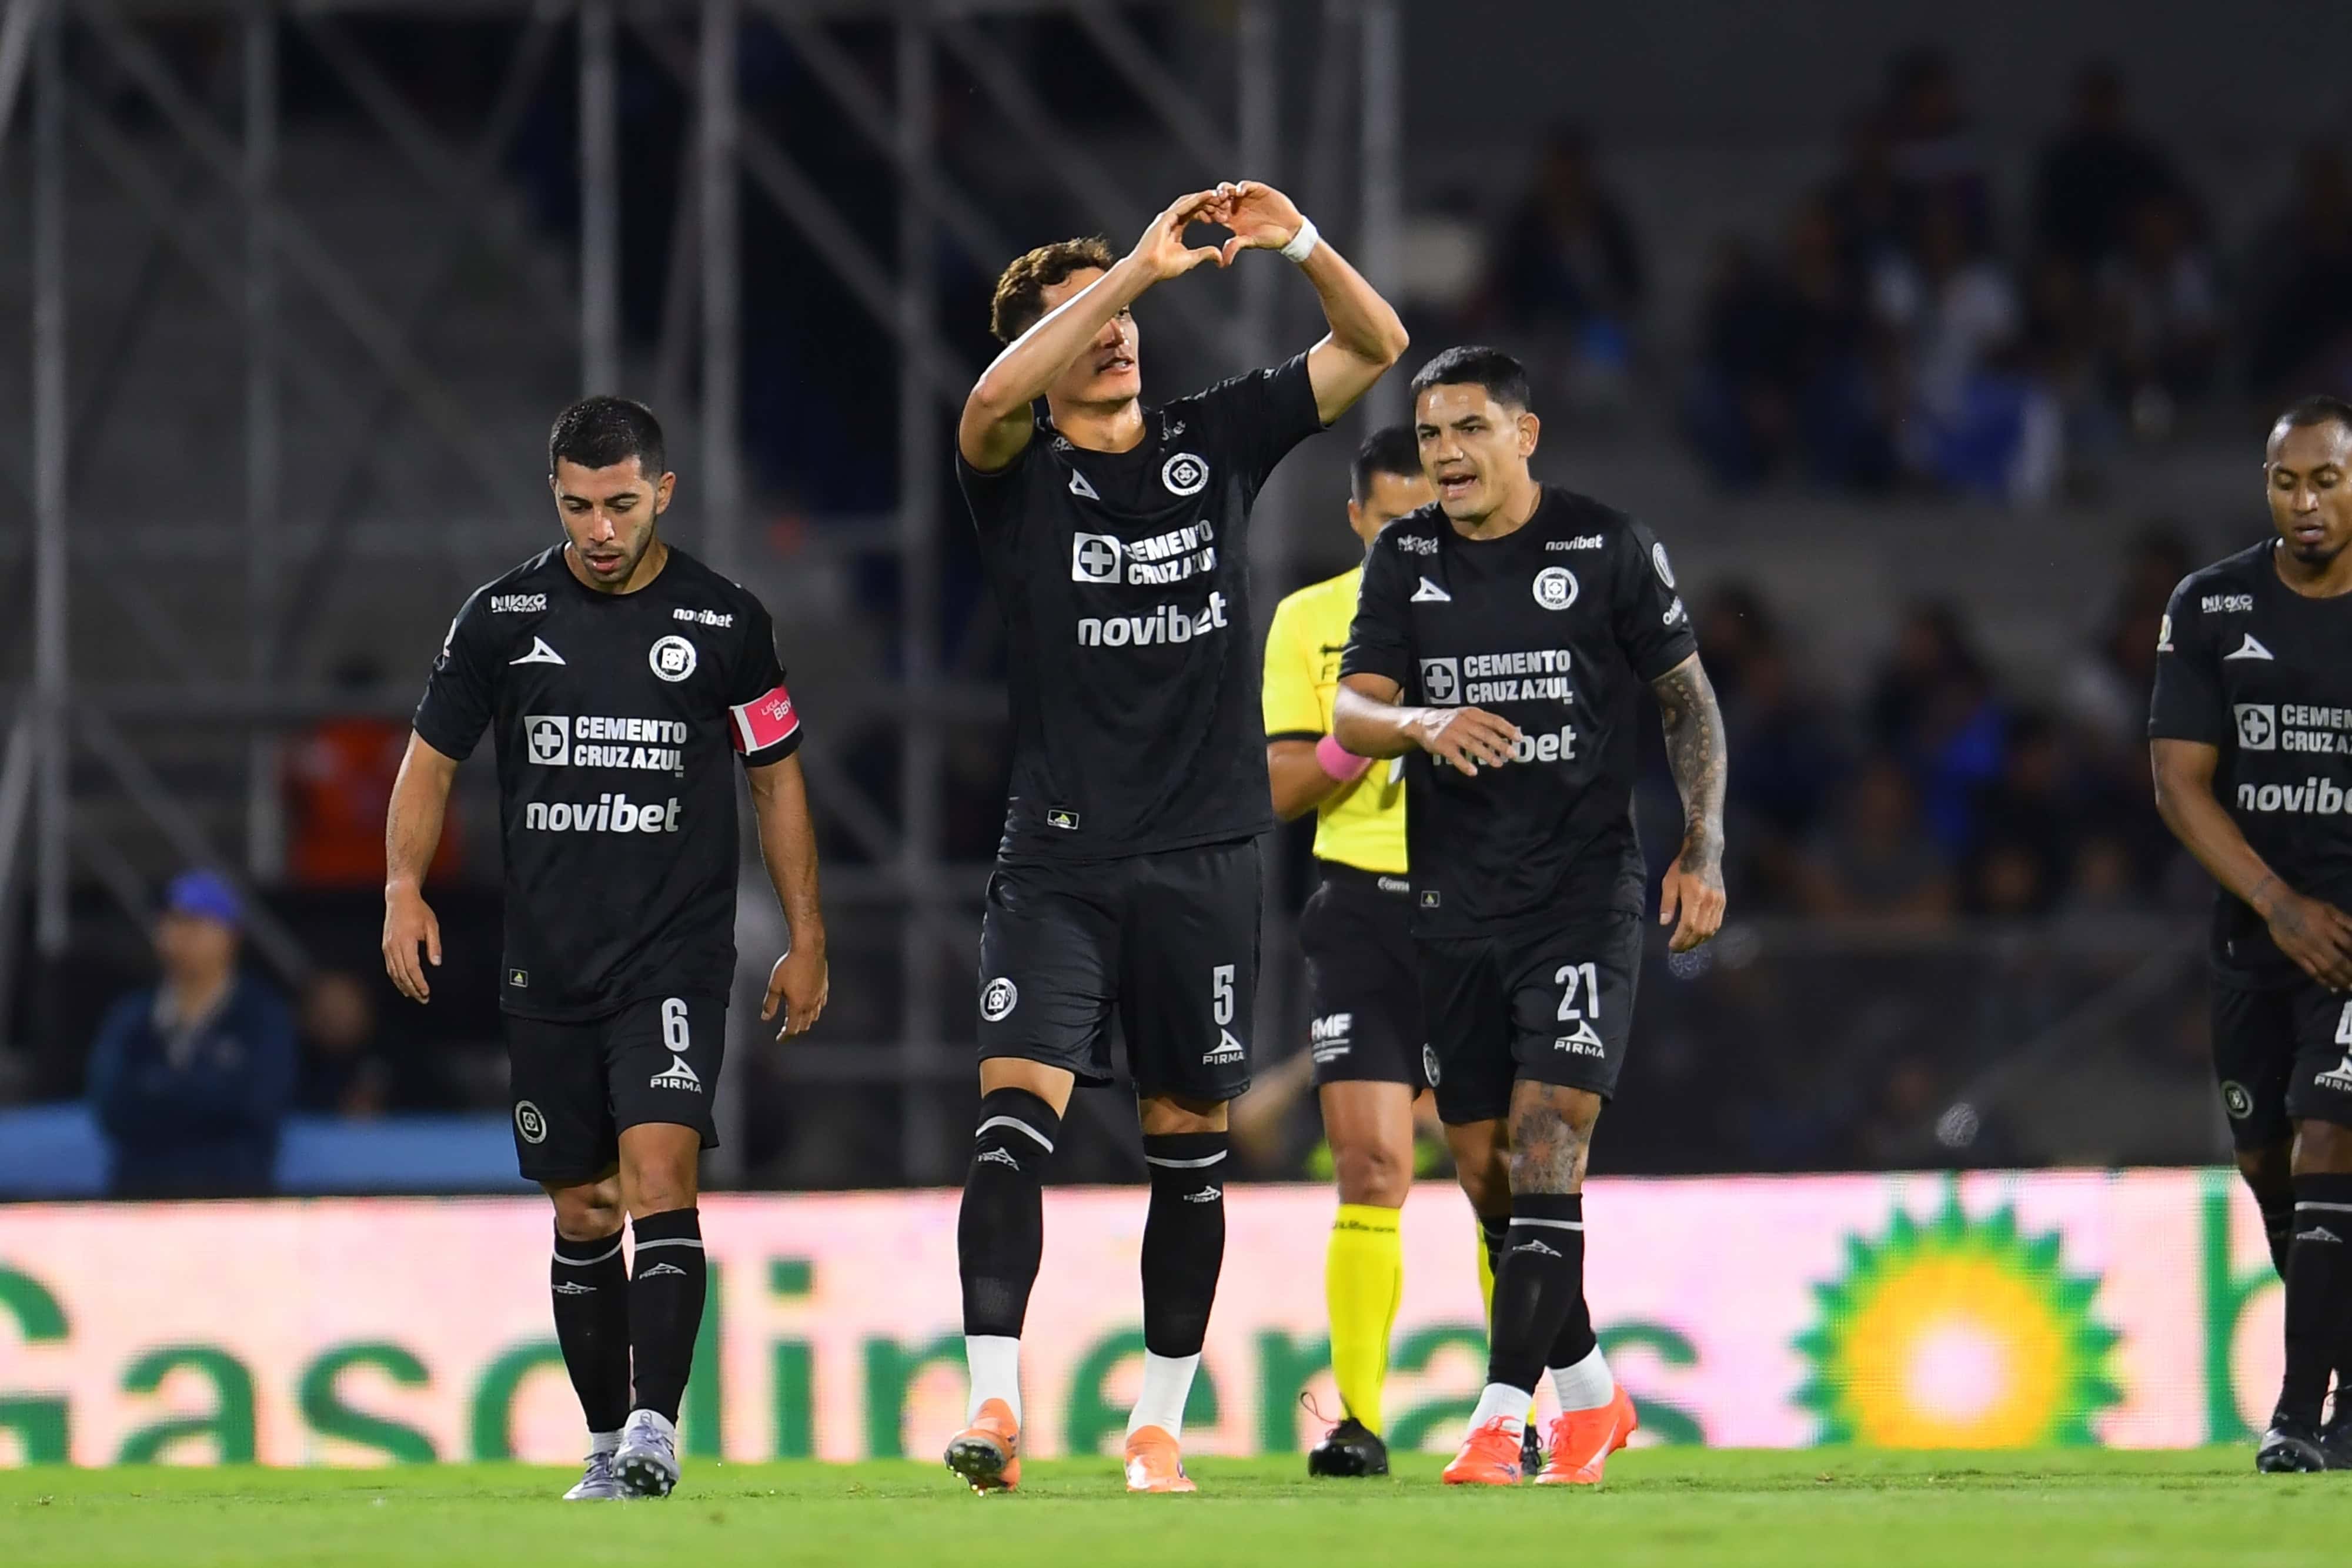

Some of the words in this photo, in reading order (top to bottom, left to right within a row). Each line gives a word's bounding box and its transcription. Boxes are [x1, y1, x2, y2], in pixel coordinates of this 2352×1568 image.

[1121, 520, 1214, 561] CEMENO
[1545, 534, 1603, 550] novibet
[1128, 557, 1182, 585] CRUZ
[673, 609, 733, 628] novibet
[1078, 591, 1228, 646] novibet
[1464, 650, 1571, 677] CEMENTO
[1466, 680, 1519, 704] CRUZ
[1521, 677, 1573, 699] AZUL
[575, 716, 687, 743] CEMENTO
[2282, 730, 2333, 753] CRUZ
[574, 744, 629, 768] CRUZ
[630, 747, 684, 771] AZUL
[526, 793, 681, 833] novibet
[1213, 964, 1234, 1025] 5
[1555, 962, 1599, 1021] 21
[662, 998, 690, 1052] 6
[1202, 1052, 1245, 1065] PIRMA
[1554, 1040, 1605, 1059] PIRMA
[650, 1078, 702, 1095] PIRMA
